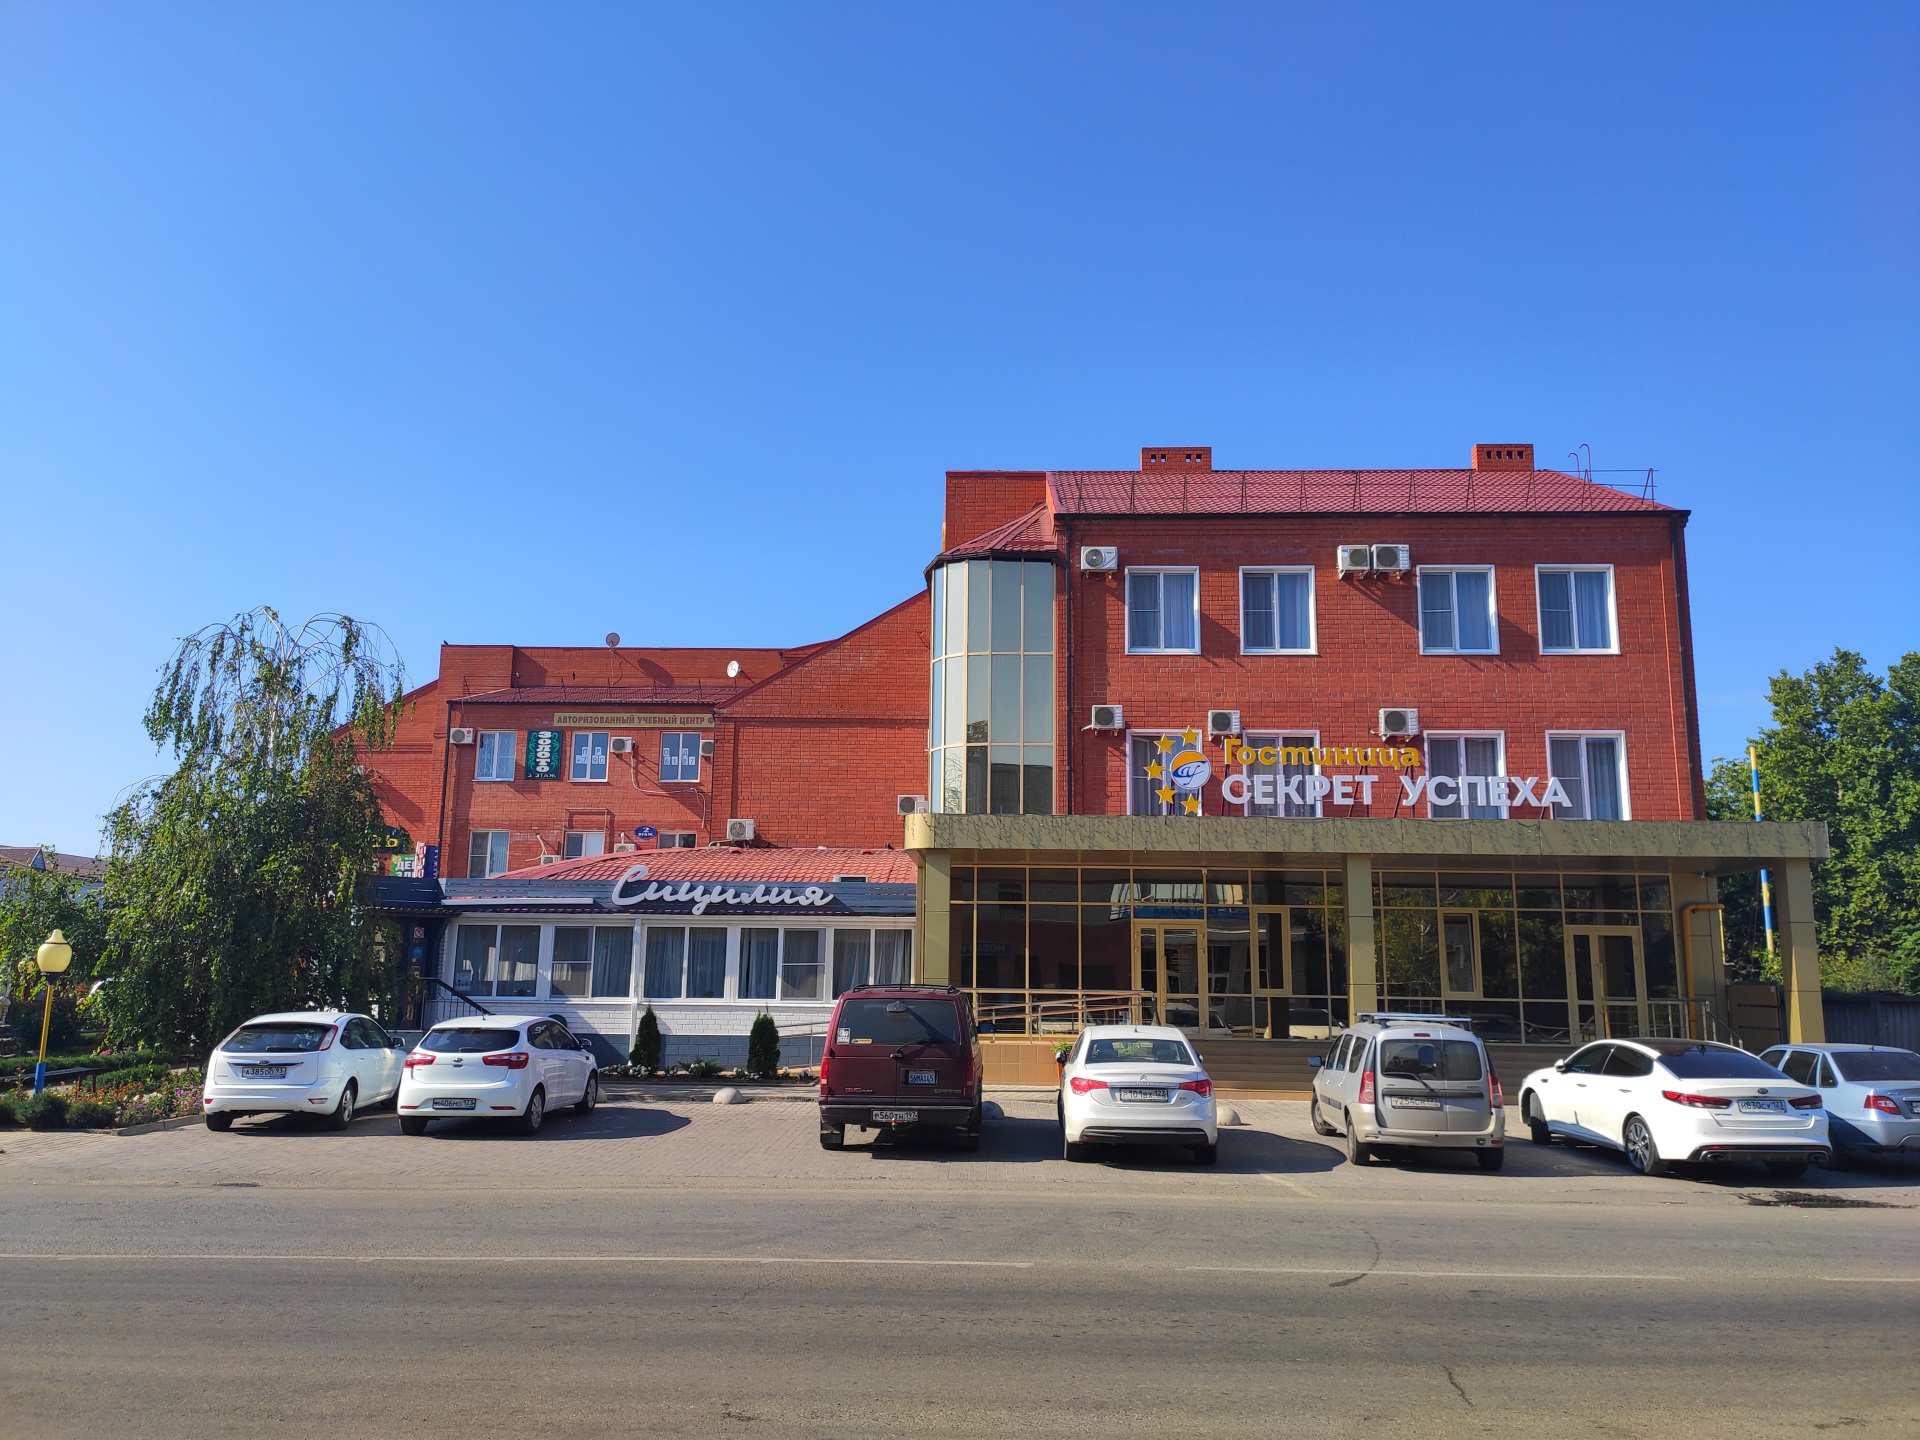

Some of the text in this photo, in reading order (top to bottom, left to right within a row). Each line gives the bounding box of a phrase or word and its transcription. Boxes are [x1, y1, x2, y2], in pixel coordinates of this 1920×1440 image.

[556, 715, 635, 725] АВТОРИЗОВАННЫЙ
[637, 715, 677, 725] УЧЕБНЫЙ
[679, 718, 705, 727] ЦЕНТР
[535, 731, 552, 773] ЗОЛОТО
[1224, 737, 1421, 771] Гостиница
[1221, 773, 1573, 808] СЕКРЕТ УСПЕХА
[611, 864, 834, 916] Сицилия
